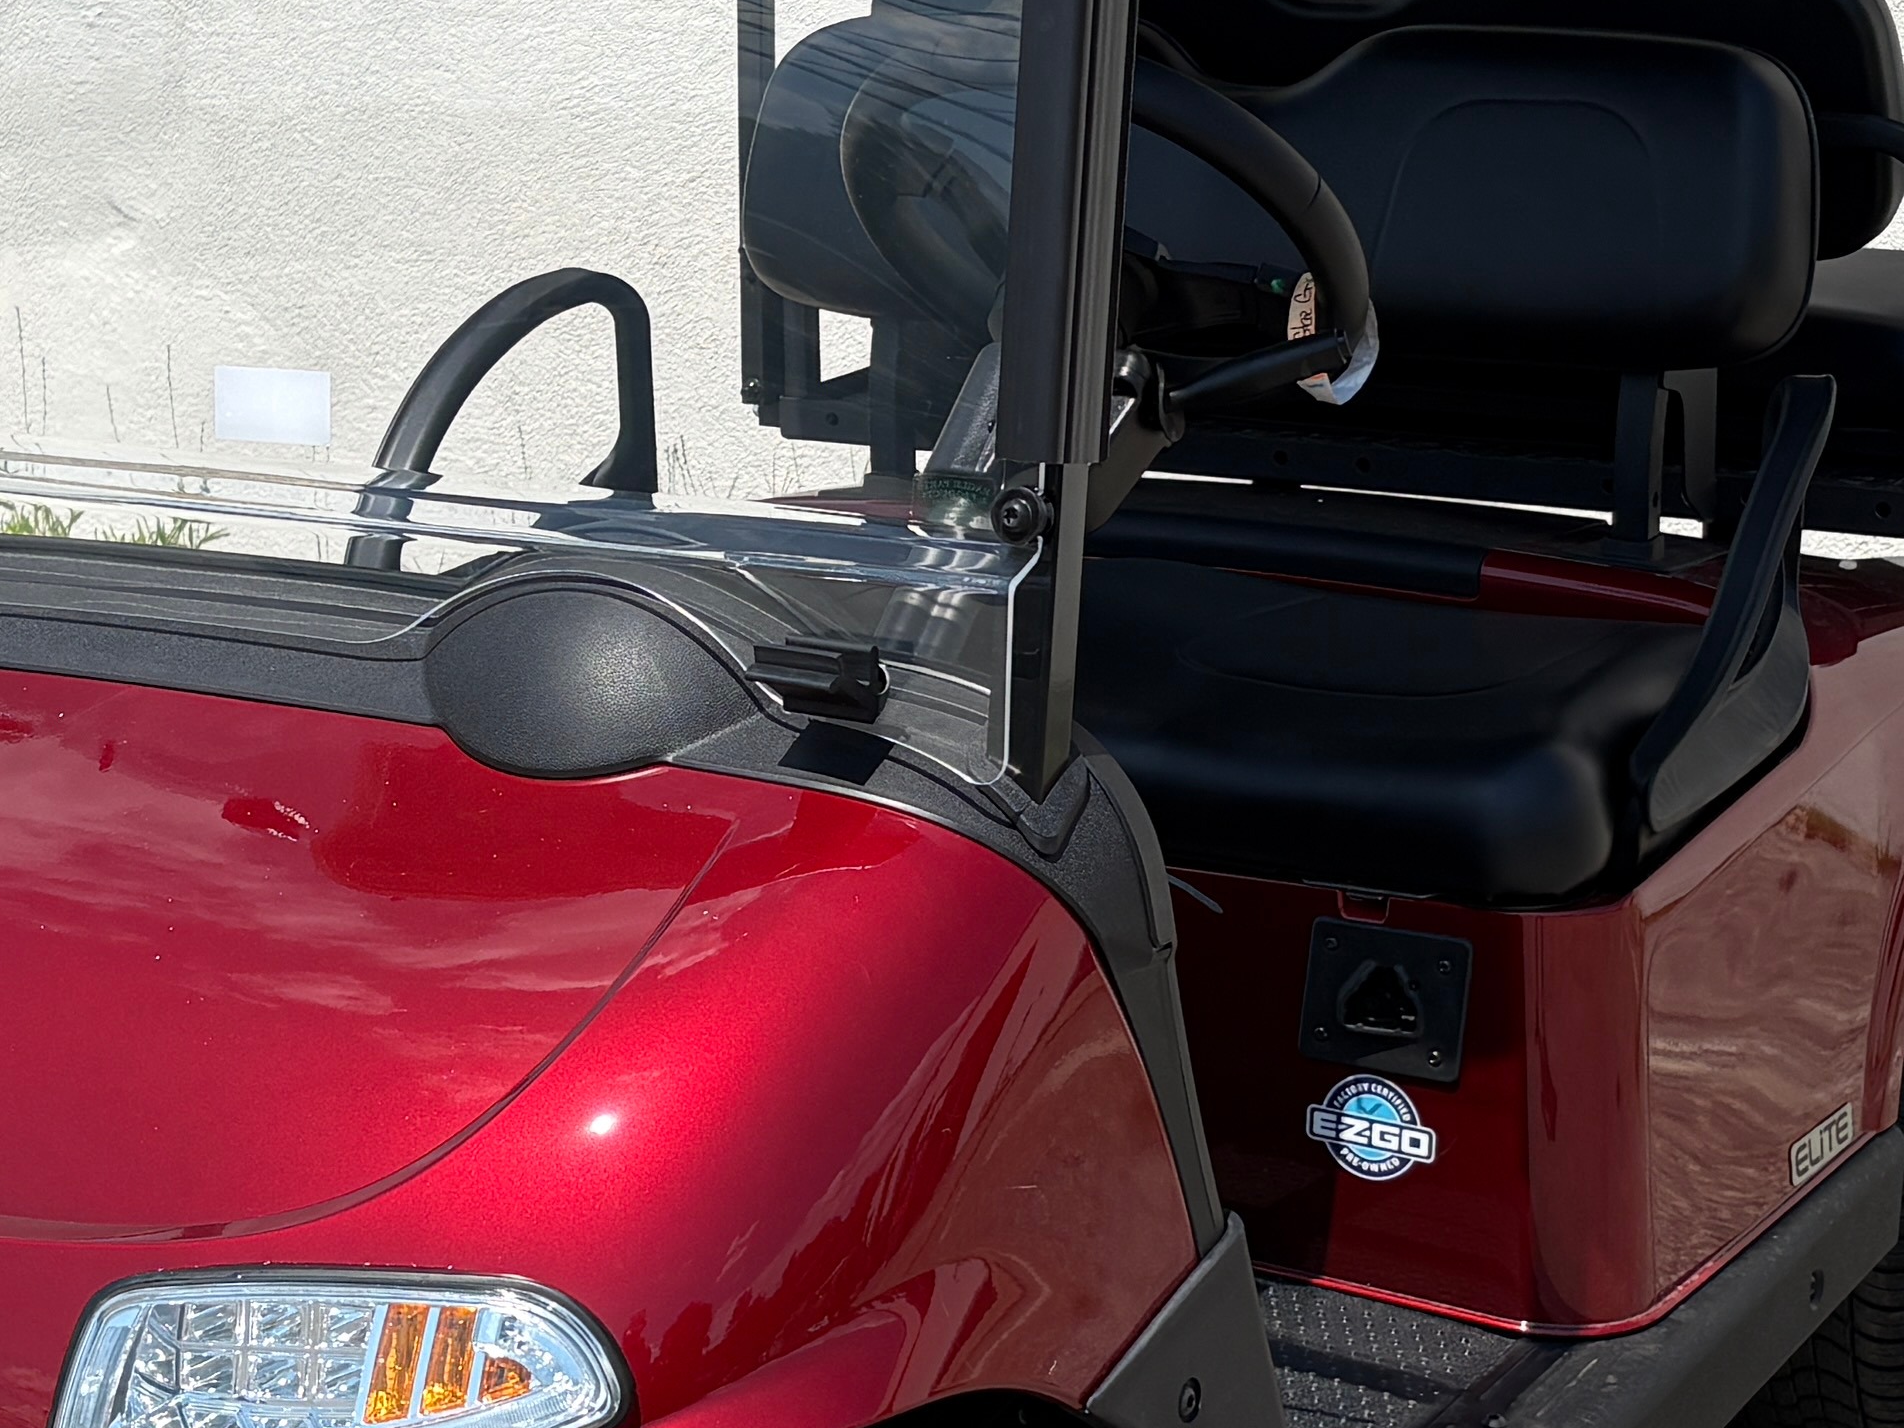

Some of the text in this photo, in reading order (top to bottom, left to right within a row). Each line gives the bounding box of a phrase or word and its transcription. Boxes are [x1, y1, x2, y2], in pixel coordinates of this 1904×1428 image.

[1333, 1082, 1412, 1122] FACTORY CERTIFIED
[1312, 1110, 1430, 1158] EZGO
[1340, 1147, 1400, 1172] PRE-OWNED
